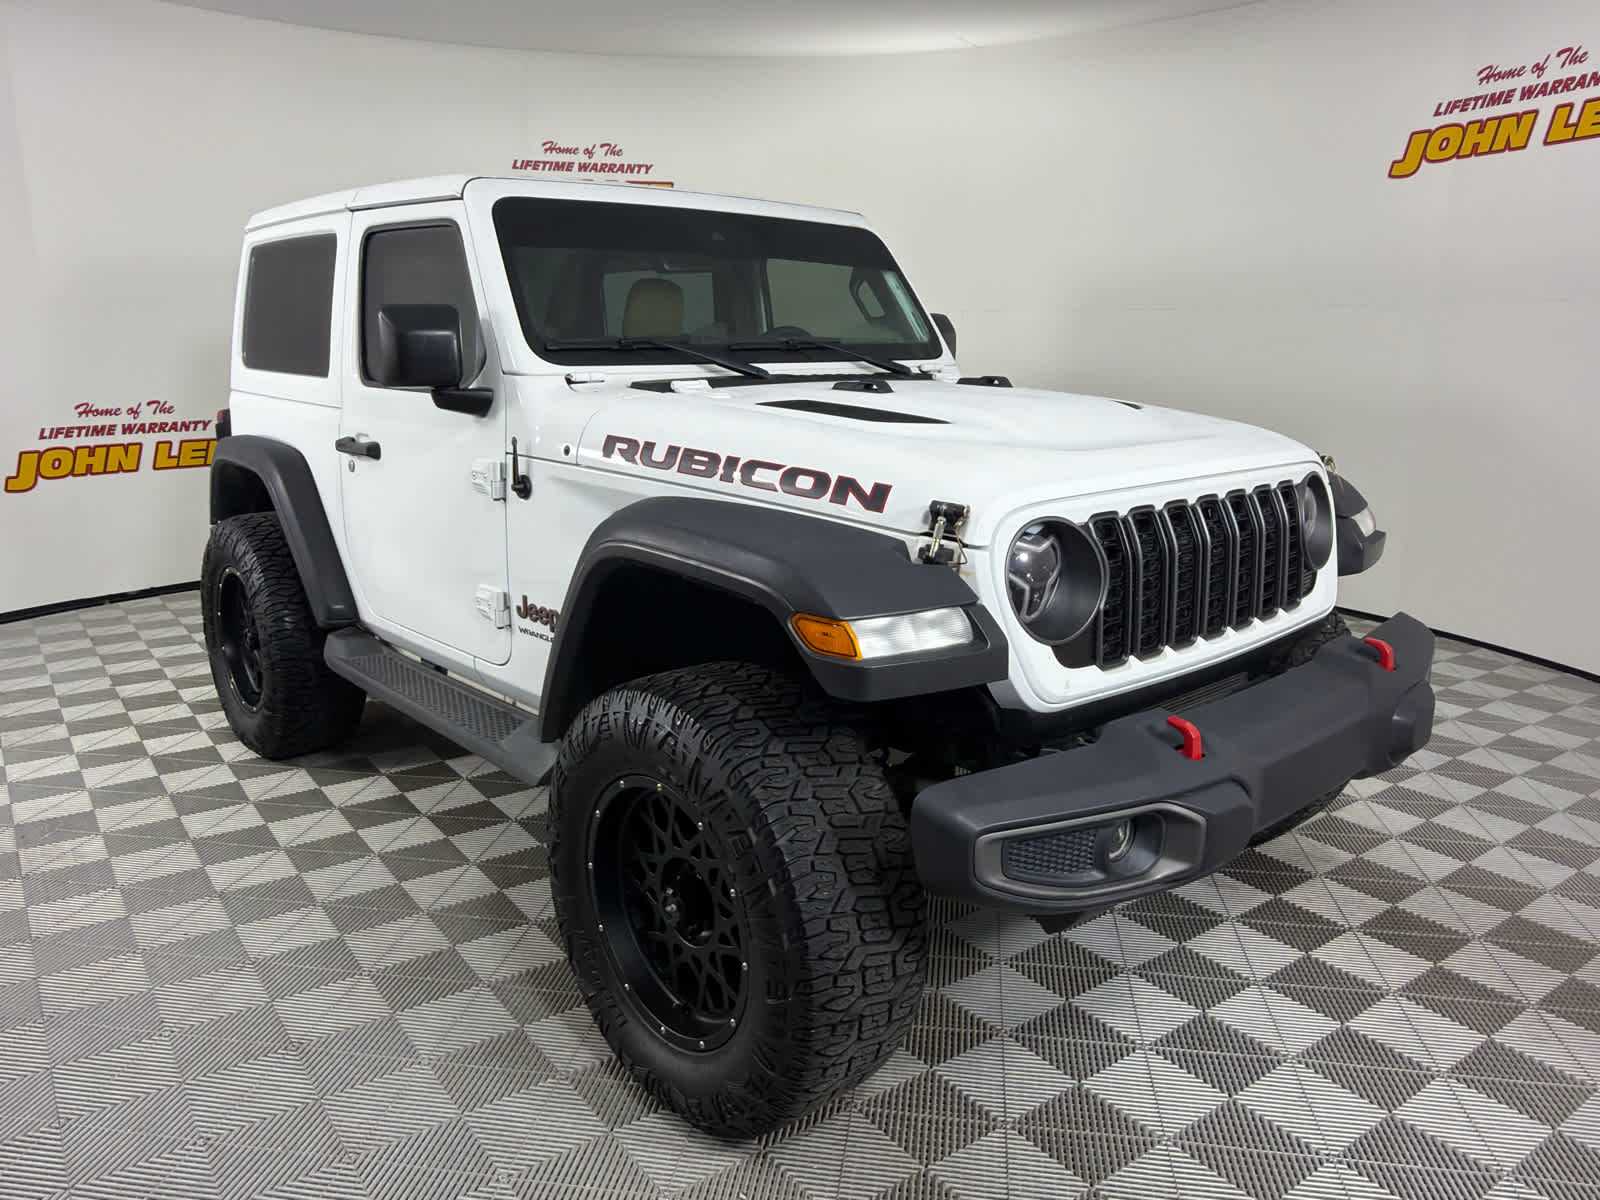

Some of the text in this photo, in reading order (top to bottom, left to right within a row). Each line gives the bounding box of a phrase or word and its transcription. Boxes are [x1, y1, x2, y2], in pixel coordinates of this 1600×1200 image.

[1477, 45, 1589, 85] Home of The
[1433, 88, 1517, 117] LIFETIME
[541, 141, 623, 160] Home of The
[1388, 108, 1540, 179] JOHN
[512, 159, 653, 174] LIFETIME WARRANTY
[74, 400, 175, 419] Home of The
[38, 419, 212, 440] LIFETIME WARRANTY
[4, 442, 143, 493] JOHN
[601, 434, 893, 514] RUBICON
[516, 594, 560, 633] Jeep
